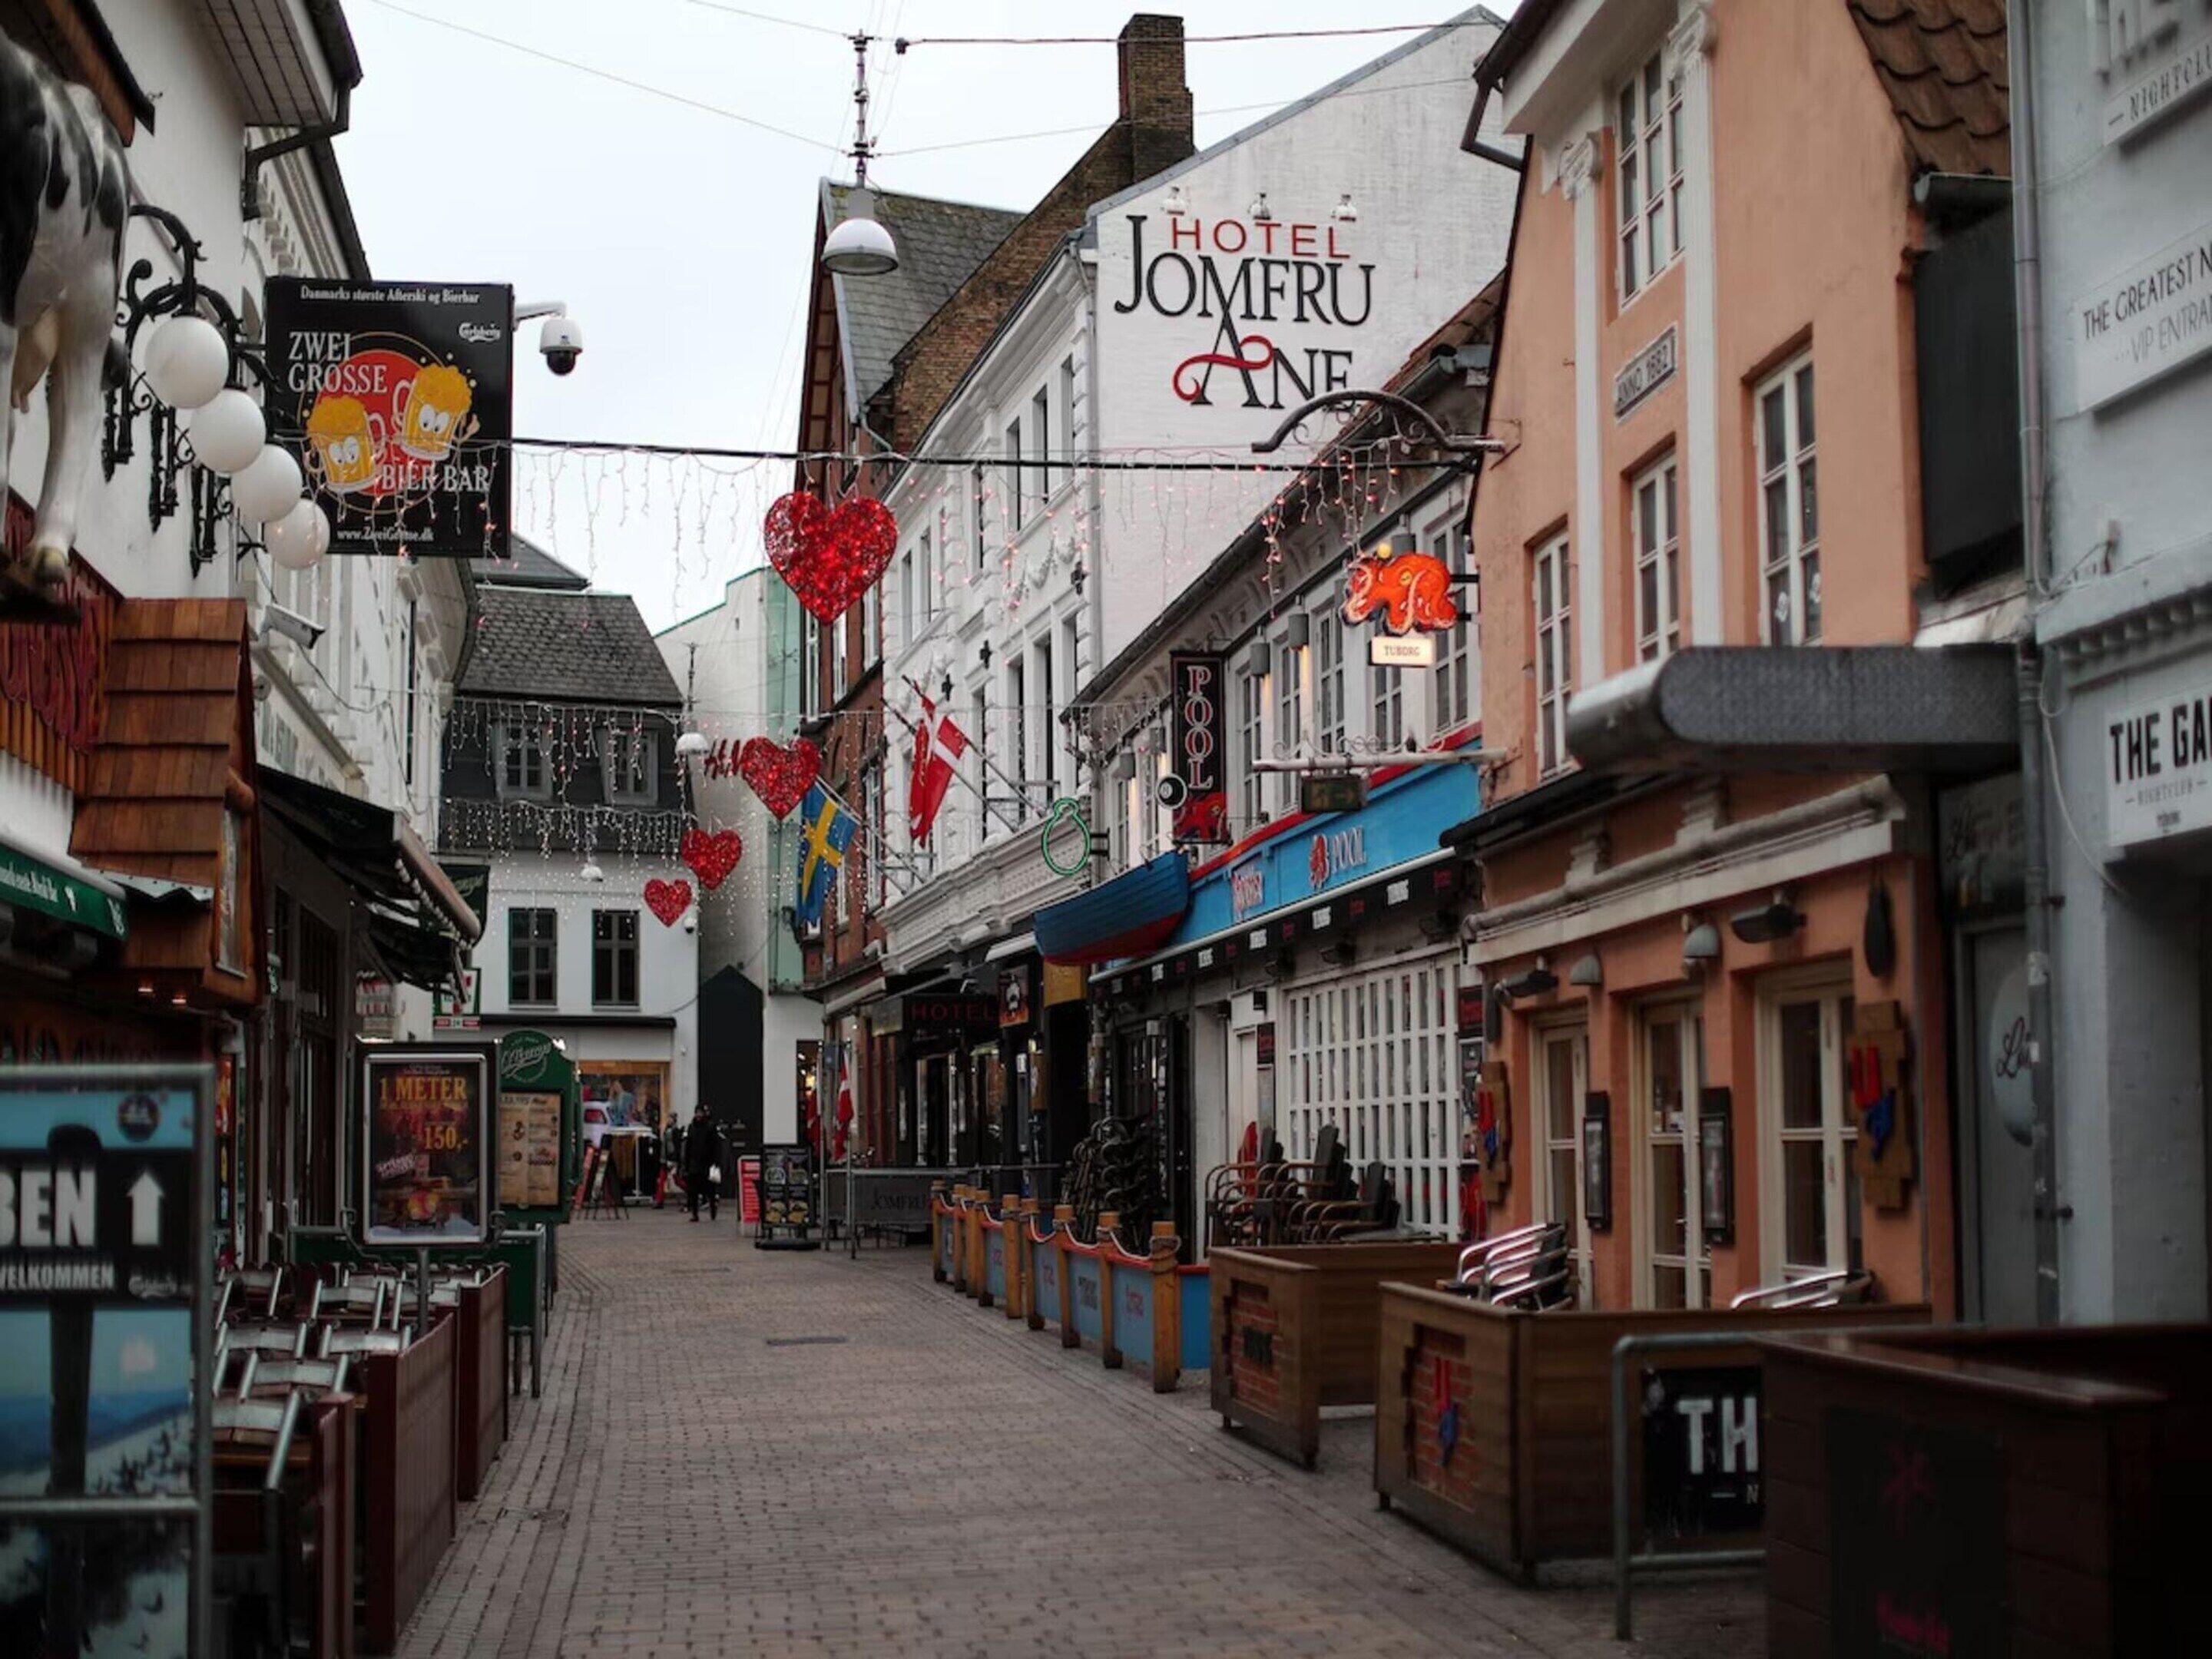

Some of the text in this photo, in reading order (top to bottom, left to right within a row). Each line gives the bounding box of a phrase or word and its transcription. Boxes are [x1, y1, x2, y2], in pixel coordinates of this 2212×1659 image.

[1171, 217, 1351, 259] HOTEL
[1114, 214, 1376, 326] JOMFRU
[300, 285, 350, 300] Danmarks
[429, 291, 441, 305] og
[442, 286, 480, 304] Bierbar
[2083, 300, 2111, 341] THE
[2114, 250, 2194, 322] GREATEST
[289, 331, 352, 361] ZWEI
[1172, 313, 1354, 409] ANE
[288, 363, 389, 394] GROSSE
[380, 462, 491, 493] BIER BAR
[1184, 665, 1214, 790] POOL
[2110, 696, 2212, 785] THE GA
[1332, 824, 1368, 875] POOL
[912, 1001, 993, 1022] HOTEL
[396, 1076, 468, 1101] METER
[1675, 1396, 1759, 1475] TH
